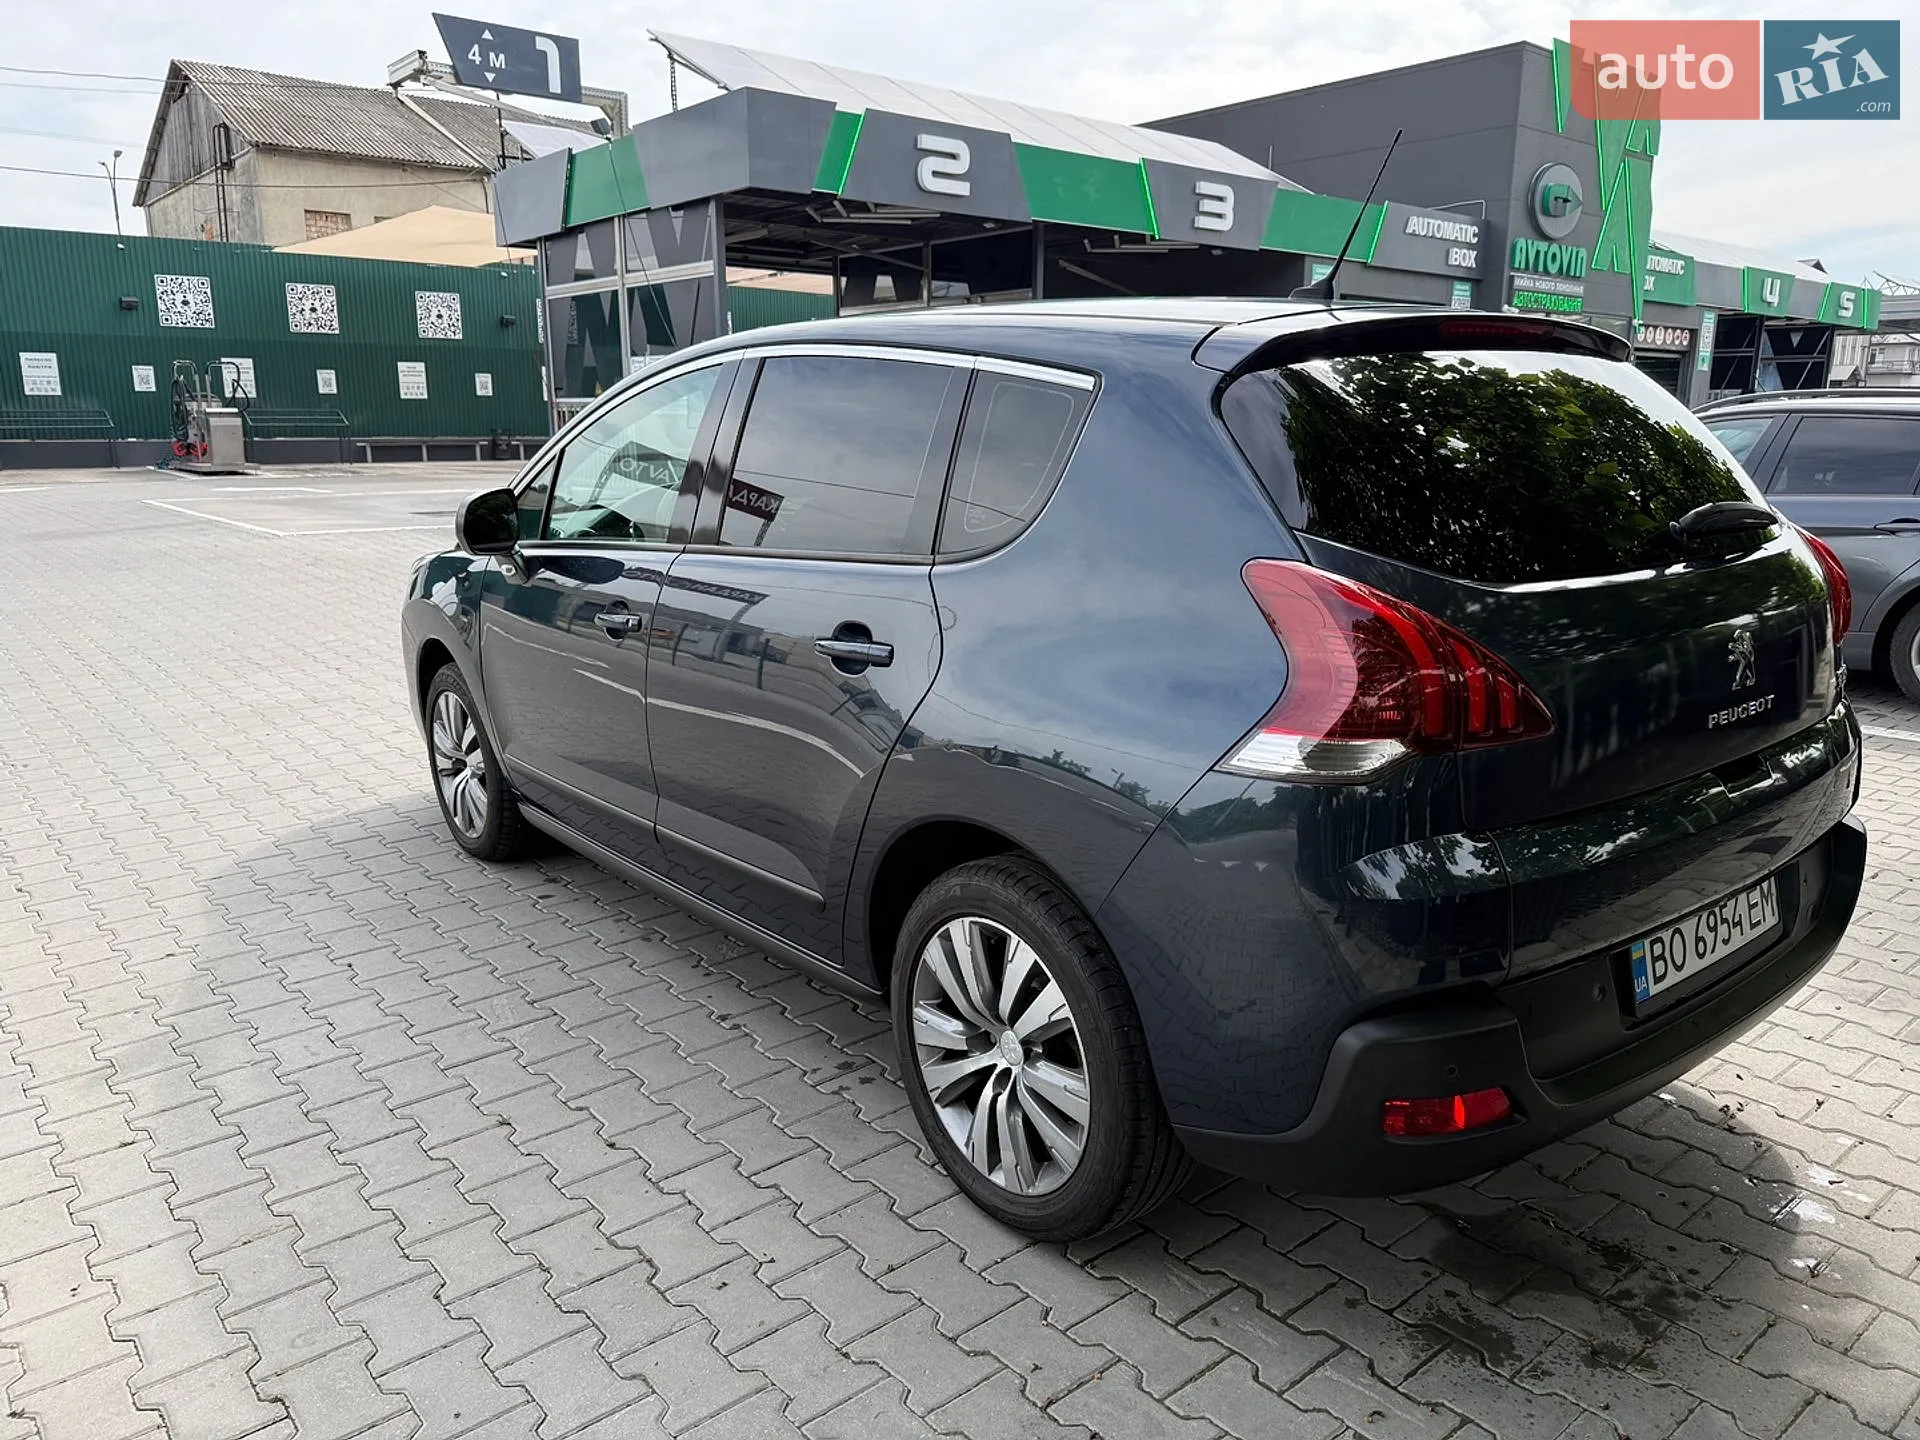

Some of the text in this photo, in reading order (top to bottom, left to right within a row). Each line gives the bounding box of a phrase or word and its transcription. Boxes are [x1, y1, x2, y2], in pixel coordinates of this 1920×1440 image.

[468, 43, 482, 65] 4
[535, 35, 562, 94] 1
[917, 133, 971, 196] 2
[1194, 181, 1234, 231] 3
[1406, 215, 1479, 244] AUTOMATIC
[1447, 247, 1477, 268] BOX
[1838, 290, 1856, 318] 5
[1708, 694, 1775, 729] PEUGEOT
[1650, 878, 1776, 986] BO 6954 EM
[1634, 975, 1648, 992] UA
